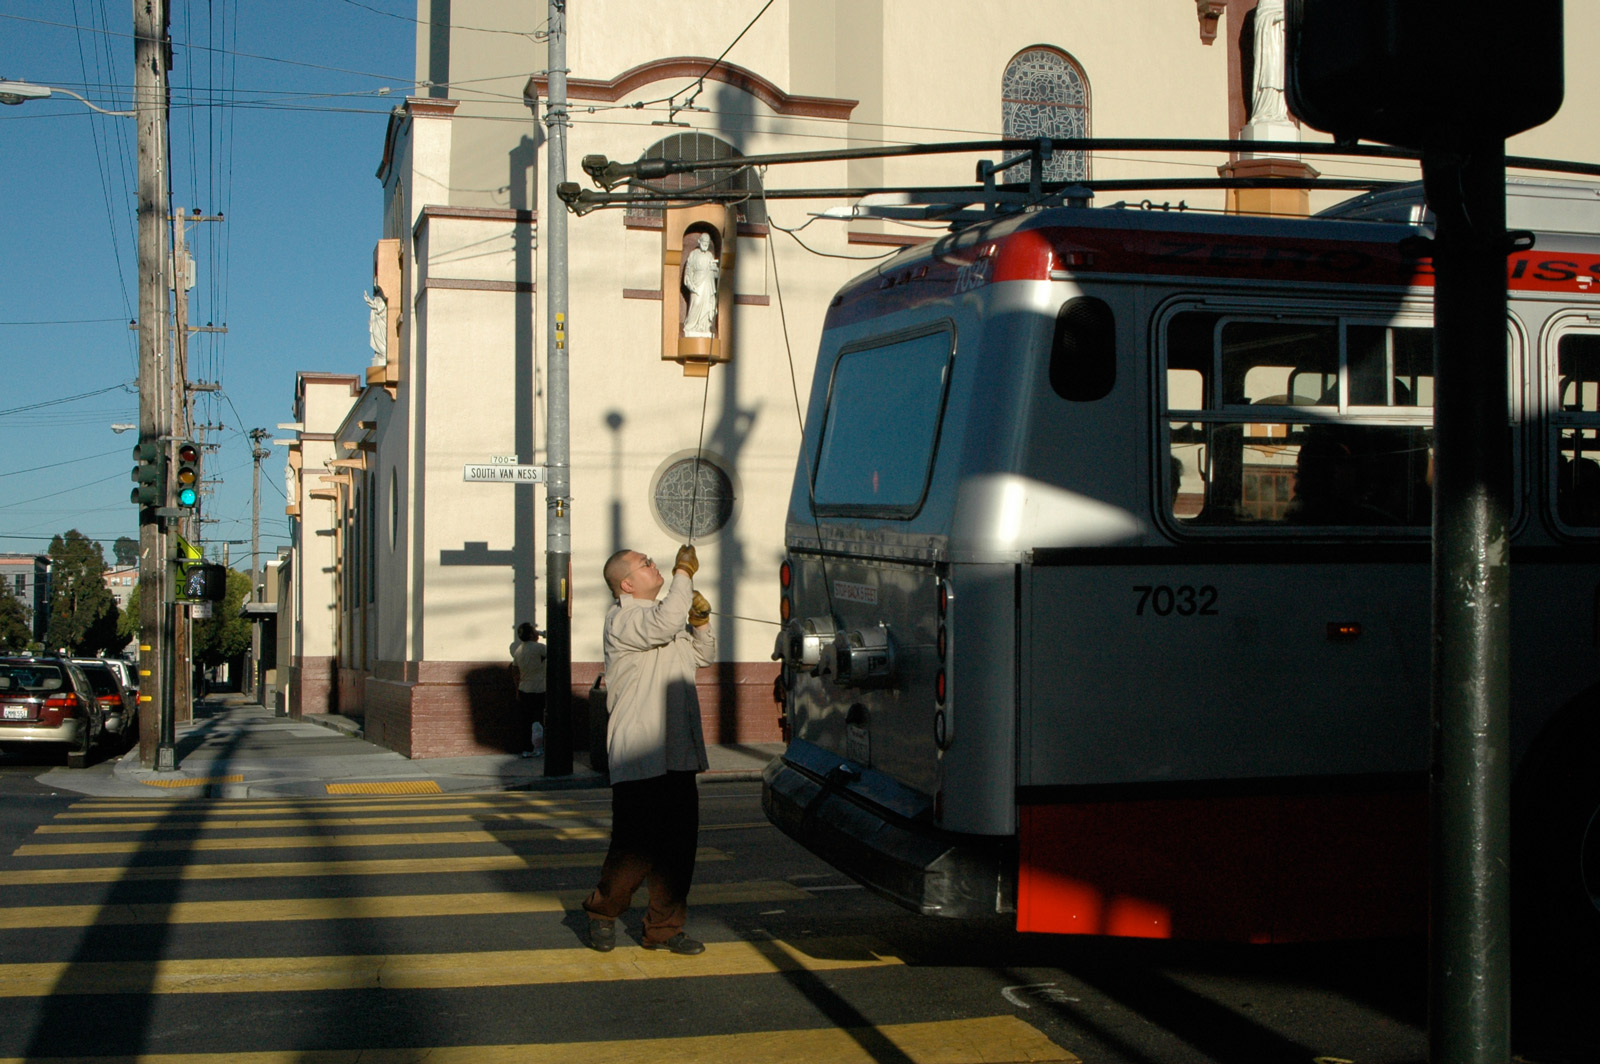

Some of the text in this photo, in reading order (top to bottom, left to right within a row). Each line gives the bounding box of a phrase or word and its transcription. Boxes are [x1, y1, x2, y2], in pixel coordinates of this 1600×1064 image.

[1151, 241, 1372, 271] ZERO
[493, 456, 509, 464] 700
[471, 467, 537, 480] SOUTH VAN NESS
[1132, 585, 1219, 616] 7032
